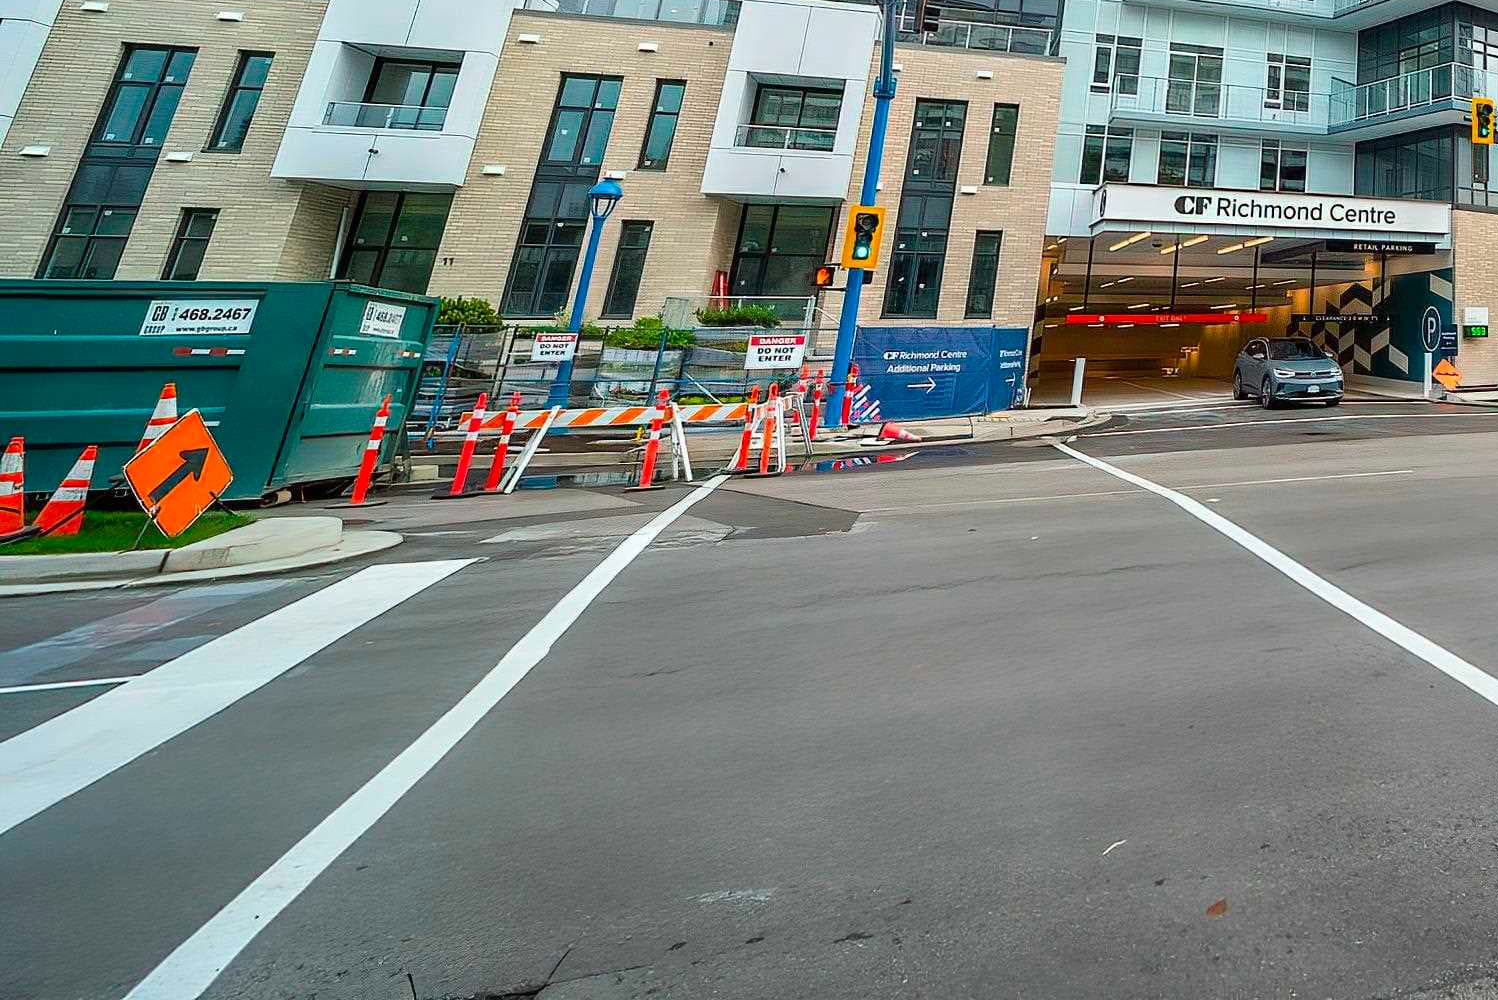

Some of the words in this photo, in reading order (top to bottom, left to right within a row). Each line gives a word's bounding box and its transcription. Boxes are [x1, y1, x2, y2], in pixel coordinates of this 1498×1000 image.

[1174, 195, 1212, 215] CF
[1216, 196, 1323, 222] Richmond
[1330, 203, 1396, 225] Centre
[1381, 244, 1413, 252] PARKING
[179, 307, 252, 321] 468.2467
[758, 337, 796, 345] DANGER
[757, 347, 772, 355] DO
[899, 351, 939, 360] Richmond
[940, 350, 968, 359] Centre
[886, 364, 929, 374] Additional
[930, 363, 961, 373] Parking
